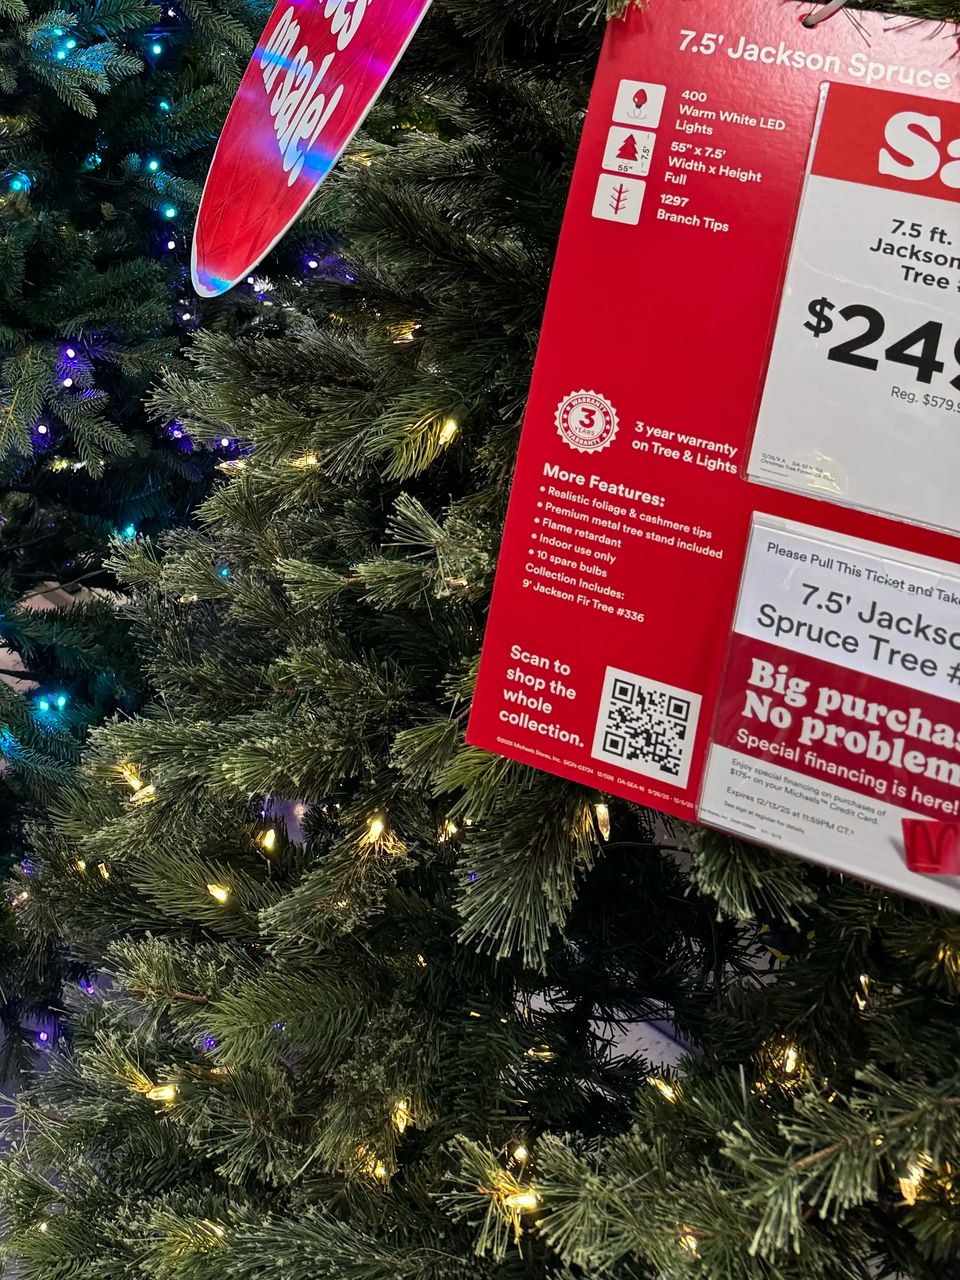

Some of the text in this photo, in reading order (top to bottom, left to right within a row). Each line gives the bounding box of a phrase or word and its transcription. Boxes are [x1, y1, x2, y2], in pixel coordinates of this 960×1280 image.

[679, 29, 952, 91] 7.5' Jackson Spruce
[260, 6, 344, 188] on sale!
[681, 90, 707, 102] 400
[675, 119, 712, 135] Lights
[680, 104, 785, 130] Warm White LED
[694, 147, 702, 155] x
[664, 171, 686, 184] Full
[668, 156, 761, 182] Width x Height
[660, 194, 689, 207] 1297
[657, 208, 728, 232] Branch Tips
[891, 219, 951, 245] 7.5 ft.
[869, 238, 960, 269] Jackson
[902, 265, 949, 289] Tree
[803, 297, 960, 392] $24
[570, 397, 607, 412] WARRANTY
[891, 386, 917, 403] Reg.
[574, 426, 595, 436] YEARS
[578, 407, 597, 429] 3
[566, 430, 601, 445] WARRANTY
[635, 421, 737, 457] 3 year warranty
[632, 440, 737, 473] on Tree & Lights
[543, 462, 665, 507] More Features:
[548, 486, 712, 538] Realistic foliage & cashmere tips
[542, 517, 621, 548] Flame retardant
[545, 501, 723, 559] Premium metal tree stand included
[537, 550, 607, 577] 10 spare bulbs
[539, 533, 616, 564] Indoor use only
[525, 563, 624, 599] Collection Includes:
[767, 541, 807, 562] Please
[810, 554, 833, 569] Pull
[836, 560, 861, 577] This
[865, 568, 904, 591] Ticket
[908, 584, 933, 597] and
[533, 582, 574, 601] Jackson
[576, 594, 590, 606] Fir
[592, 599, 614, 613] Tree
[616, 608, 644, 622] #336
[802, 583, 851, 613] 7.5'
[757, 604, 858, 653] Spruce
[869, 634, 937, 676] Tree
[510, 645, 570, 675] Scan to
[506, 667, 576, 699] shop the
[503, 689, 552, 713] whole
[741, 689, 791, 728] No
[747, 658, 960, 751] Big purcha
[499, 710, 584, 747] collection.
[513, 742, 534, 753] Michaels
[535, 749, 551, 760] Stores,
[732, 758, 752, 771] Enjoy
[754, 768, 781, 780] special
[783, 776, 819, 795] financing
[833, 795, 875, 813] purchases
[736, 728, 959, 815] Special financing is here!
[726, 786, 754, 801] Expires
[757, 796, 790, 815] 12/13/25
[792, 811, 800, 819] at
[802, 812, 835, 831] 11:59PM
[730, 768, 751, 779] $175+
[765, 781, 782, 791] your
[829, 802, 855, 816] Credit
[856, 812, 877, 824] Card.
